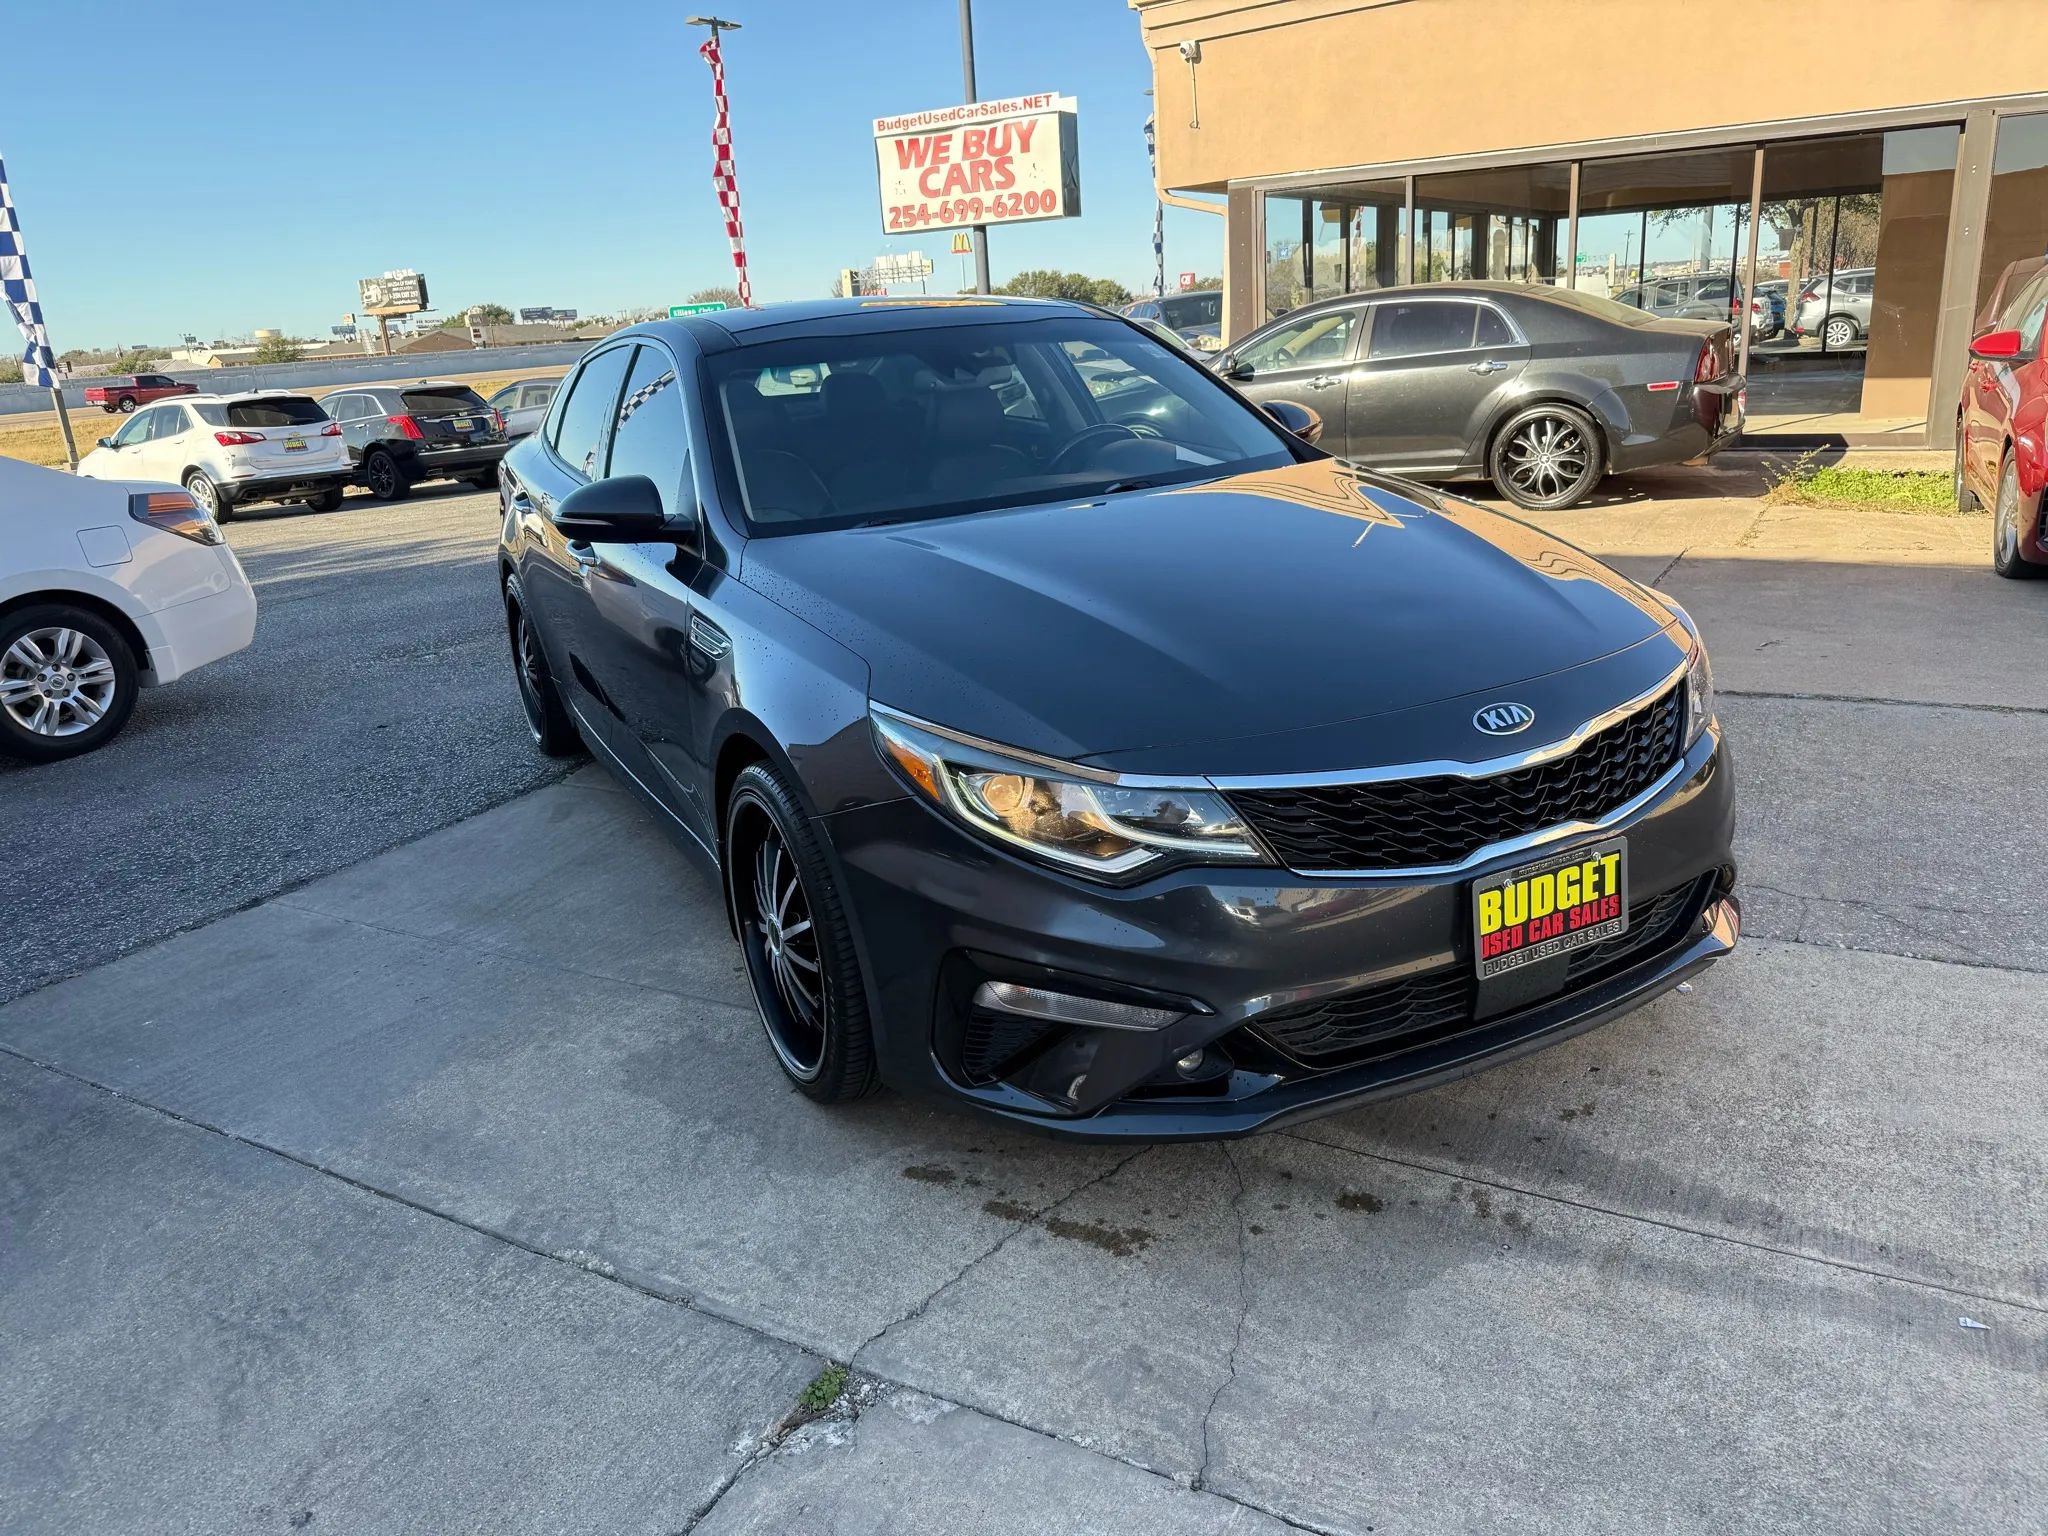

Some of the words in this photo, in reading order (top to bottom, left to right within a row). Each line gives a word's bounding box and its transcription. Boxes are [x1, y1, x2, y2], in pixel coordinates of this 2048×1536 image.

[877, 95, 1053, 132] BudgetUsedCarSales.NET
[894, 134, 953, 170] WE
[962, 119, 1039, 161] BUY
[918, 156, 1016, 198] CARS
[889, 189, 1057, 229] 254-699-6200
[1481, 705, 1530, 730] KIA
[1479, 853, 1620, 936] BUDGET
[1529, 912, 1563, 942] CAR
[1569, 895, 1621, 930] SALES
[1485, 951, 1529, 975] BUDGET
[1532, 941, 1561, 958] USED
[1564, 936, 1585, 949] CAR
[1587, 921, 1620, 940] SALES
